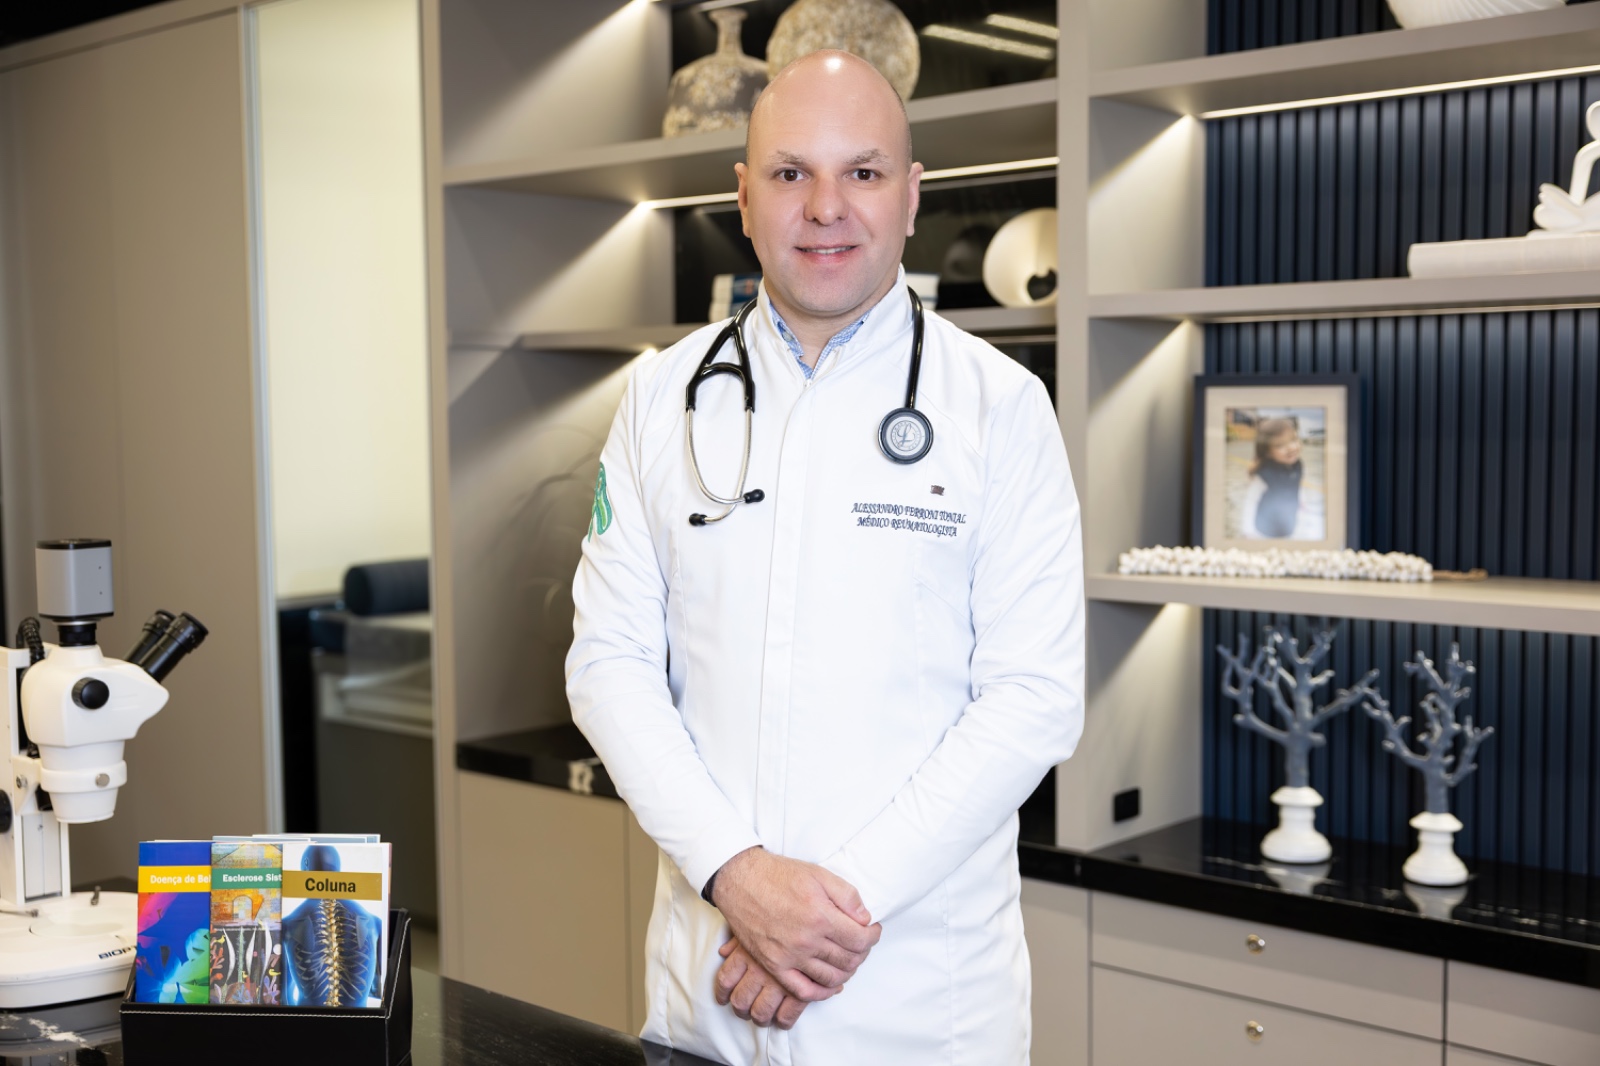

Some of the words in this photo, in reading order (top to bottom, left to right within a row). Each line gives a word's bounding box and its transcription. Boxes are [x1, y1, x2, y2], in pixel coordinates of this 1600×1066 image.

[851, 502, 904, 516] ALESSANDRO
[856, 514, 890, 529] MÉDICO
[890, 518, 958, 537] REUMATOLOGISTA
[150, 874, 182, 886] Doença
[184, 874, 196, 884] de
[222, 874, 264, 883] Esclerose
[265, 873, 283, 882] Sist
[305, 877, 356, 893] Coluna
